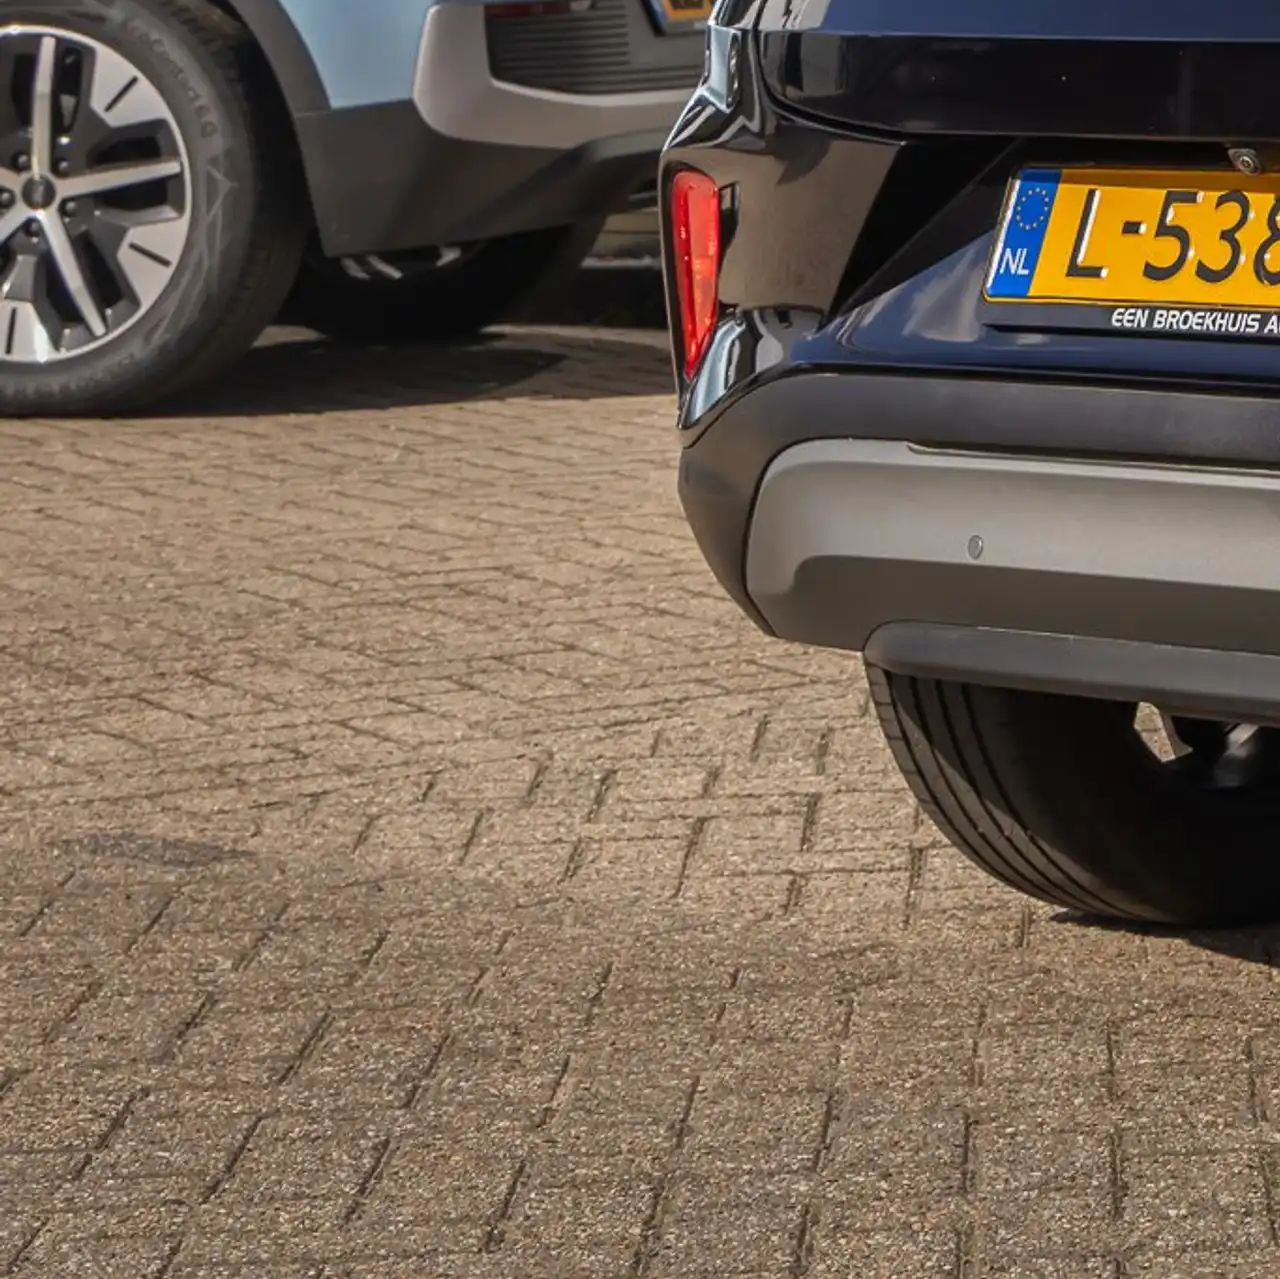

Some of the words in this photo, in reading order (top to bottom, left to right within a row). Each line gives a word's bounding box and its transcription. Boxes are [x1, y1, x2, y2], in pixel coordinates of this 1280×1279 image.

[1000, 248, 1029, 275] NL
[1111, 308, 1149, 328] EEN
[1153, 310, 1260, 333] BROEKHUIS
